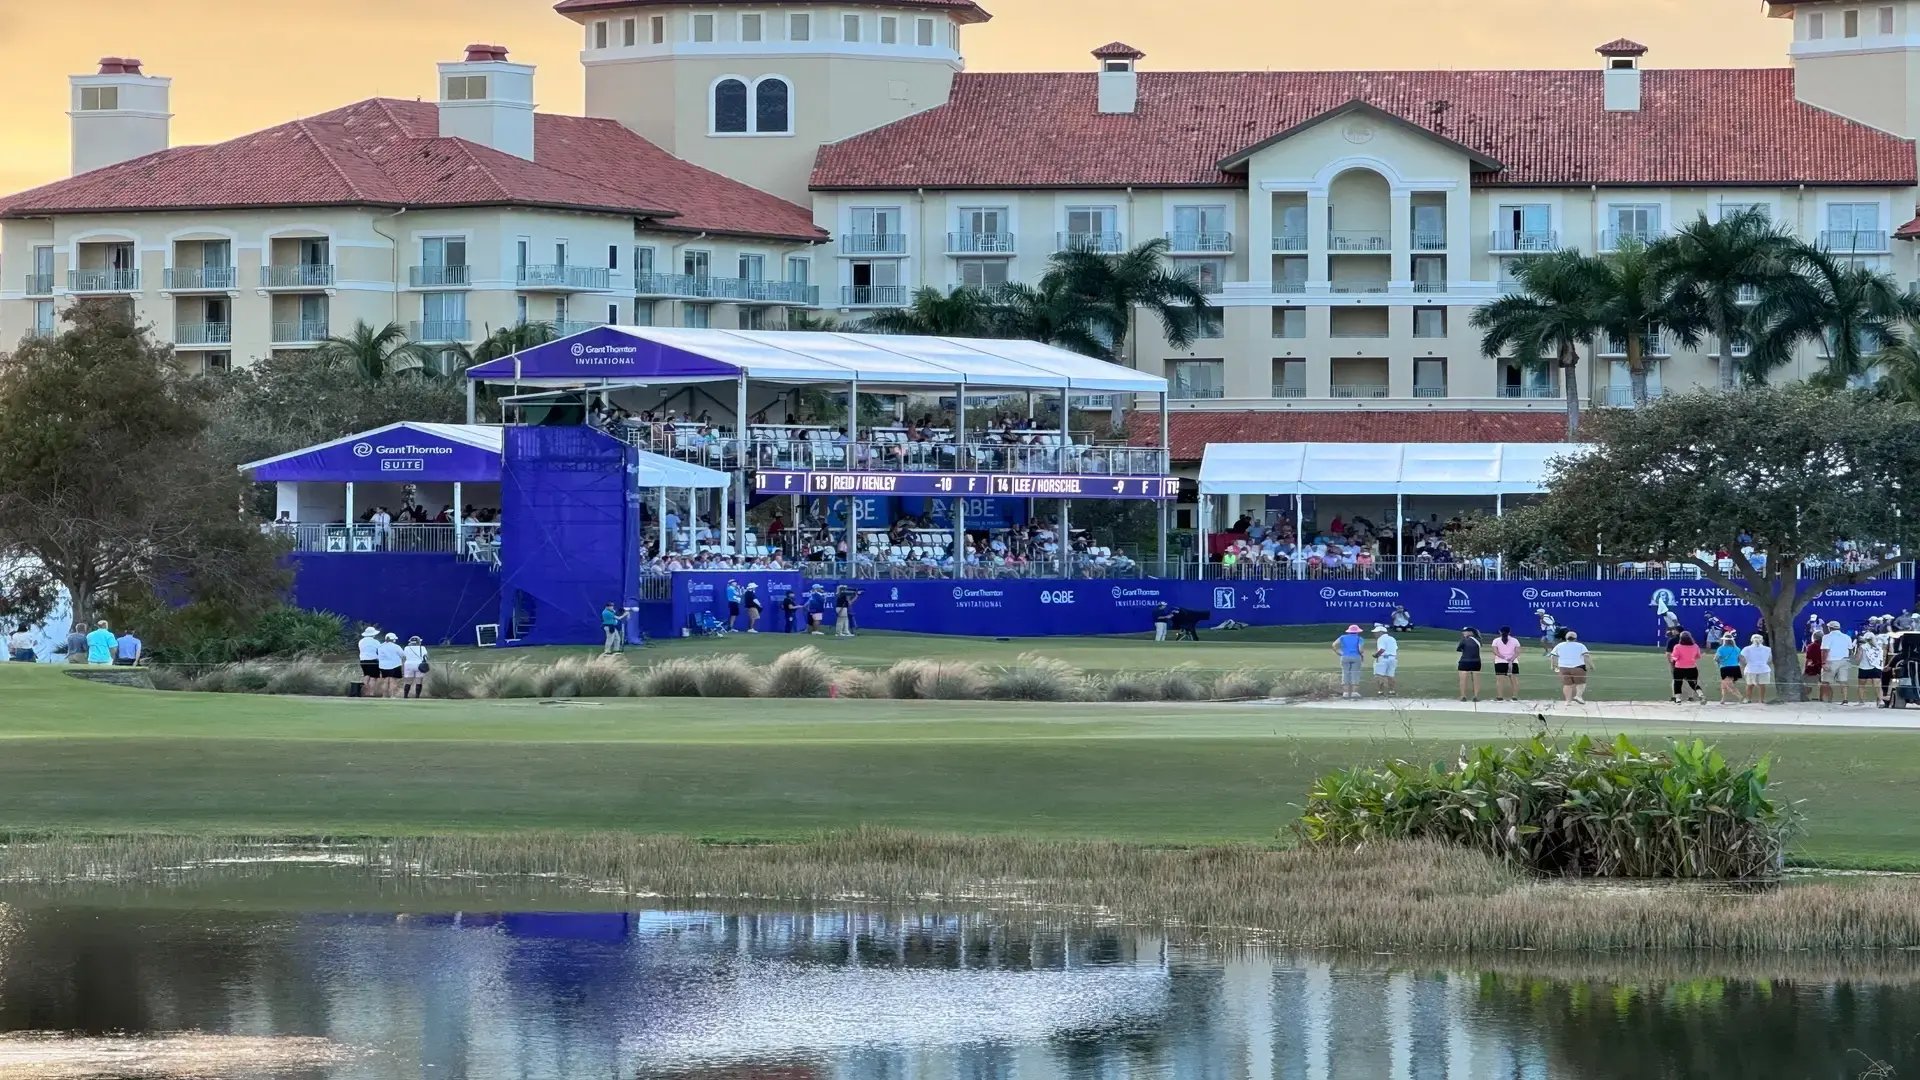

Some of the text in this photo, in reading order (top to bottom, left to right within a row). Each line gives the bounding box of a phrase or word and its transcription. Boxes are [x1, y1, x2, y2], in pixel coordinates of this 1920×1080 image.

[575, 357, 635, 365] INVITATIONAL
[383, 461, 421, 469] SUITE
[784, 475, 792, 489] F
[815, 476, 827, 490] 13
[861, 476, 896, 491] HENLEY
[934, 477, 952, 491] -10
[968, 477, 976, 491] F
[997, 478, 1008, 492] 14
[1037, 479, 1082, 493] HORSCHEL
[1112, 480, 1124, 494] -9
[1142, 480, 1149, 494] F
[1052, 590, 1075, 604] QBE
[1680, 597, 1754, 606] TEMPLETO
